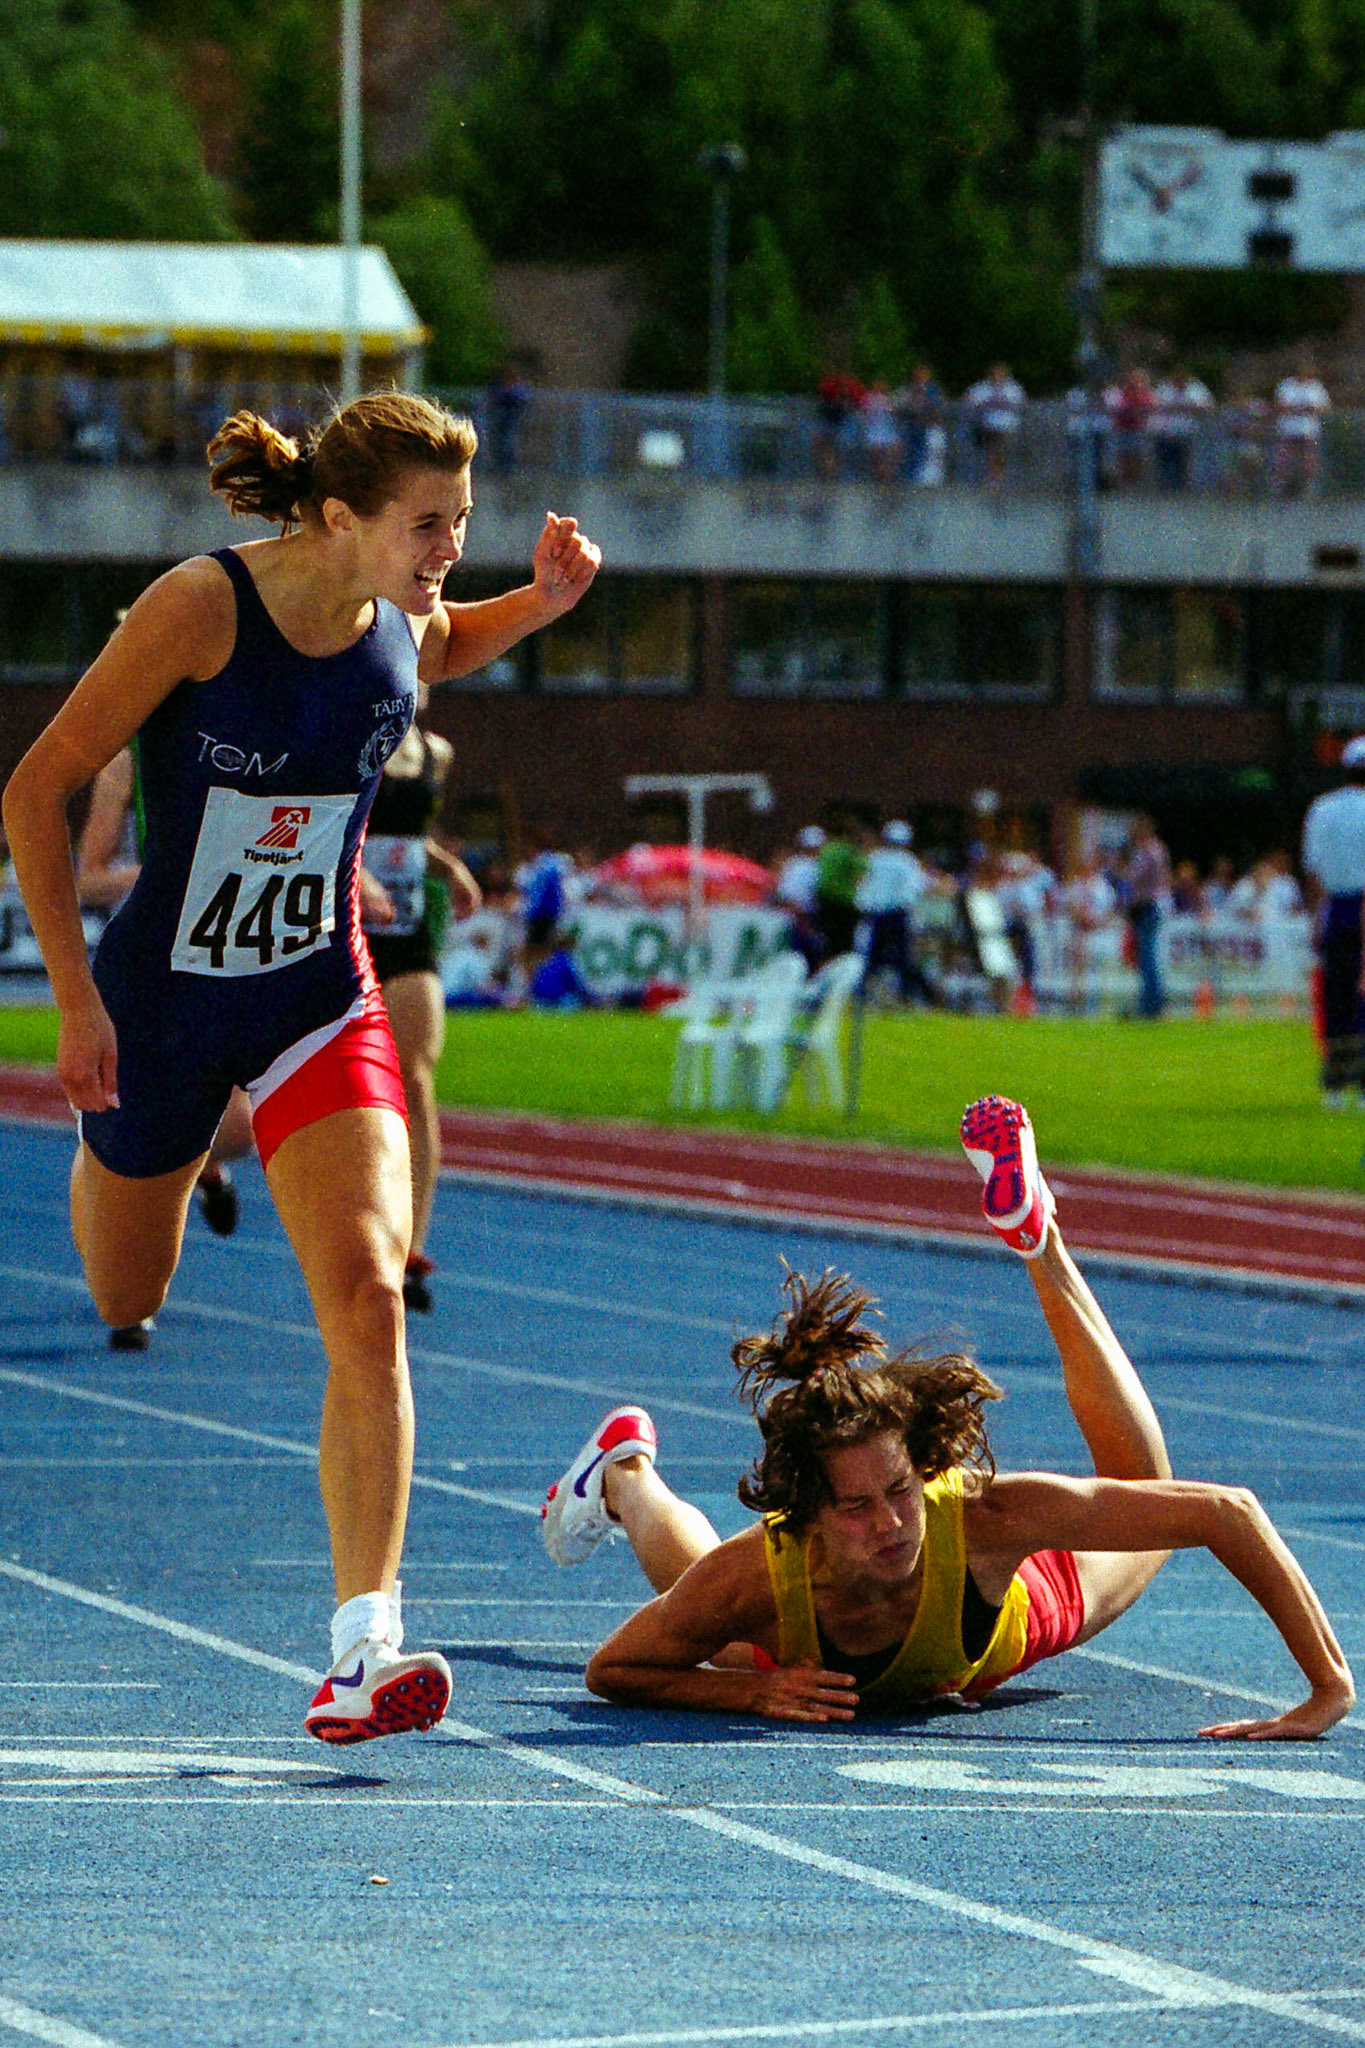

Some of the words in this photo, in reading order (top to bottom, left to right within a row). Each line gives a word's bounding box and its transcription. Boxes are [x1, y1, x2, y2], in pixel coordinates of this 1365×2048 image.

[372, 697, 407, 717] TÄBY
[243, 848, 304, 866] Tipstjät
[188, 872, 325, 968] 449
